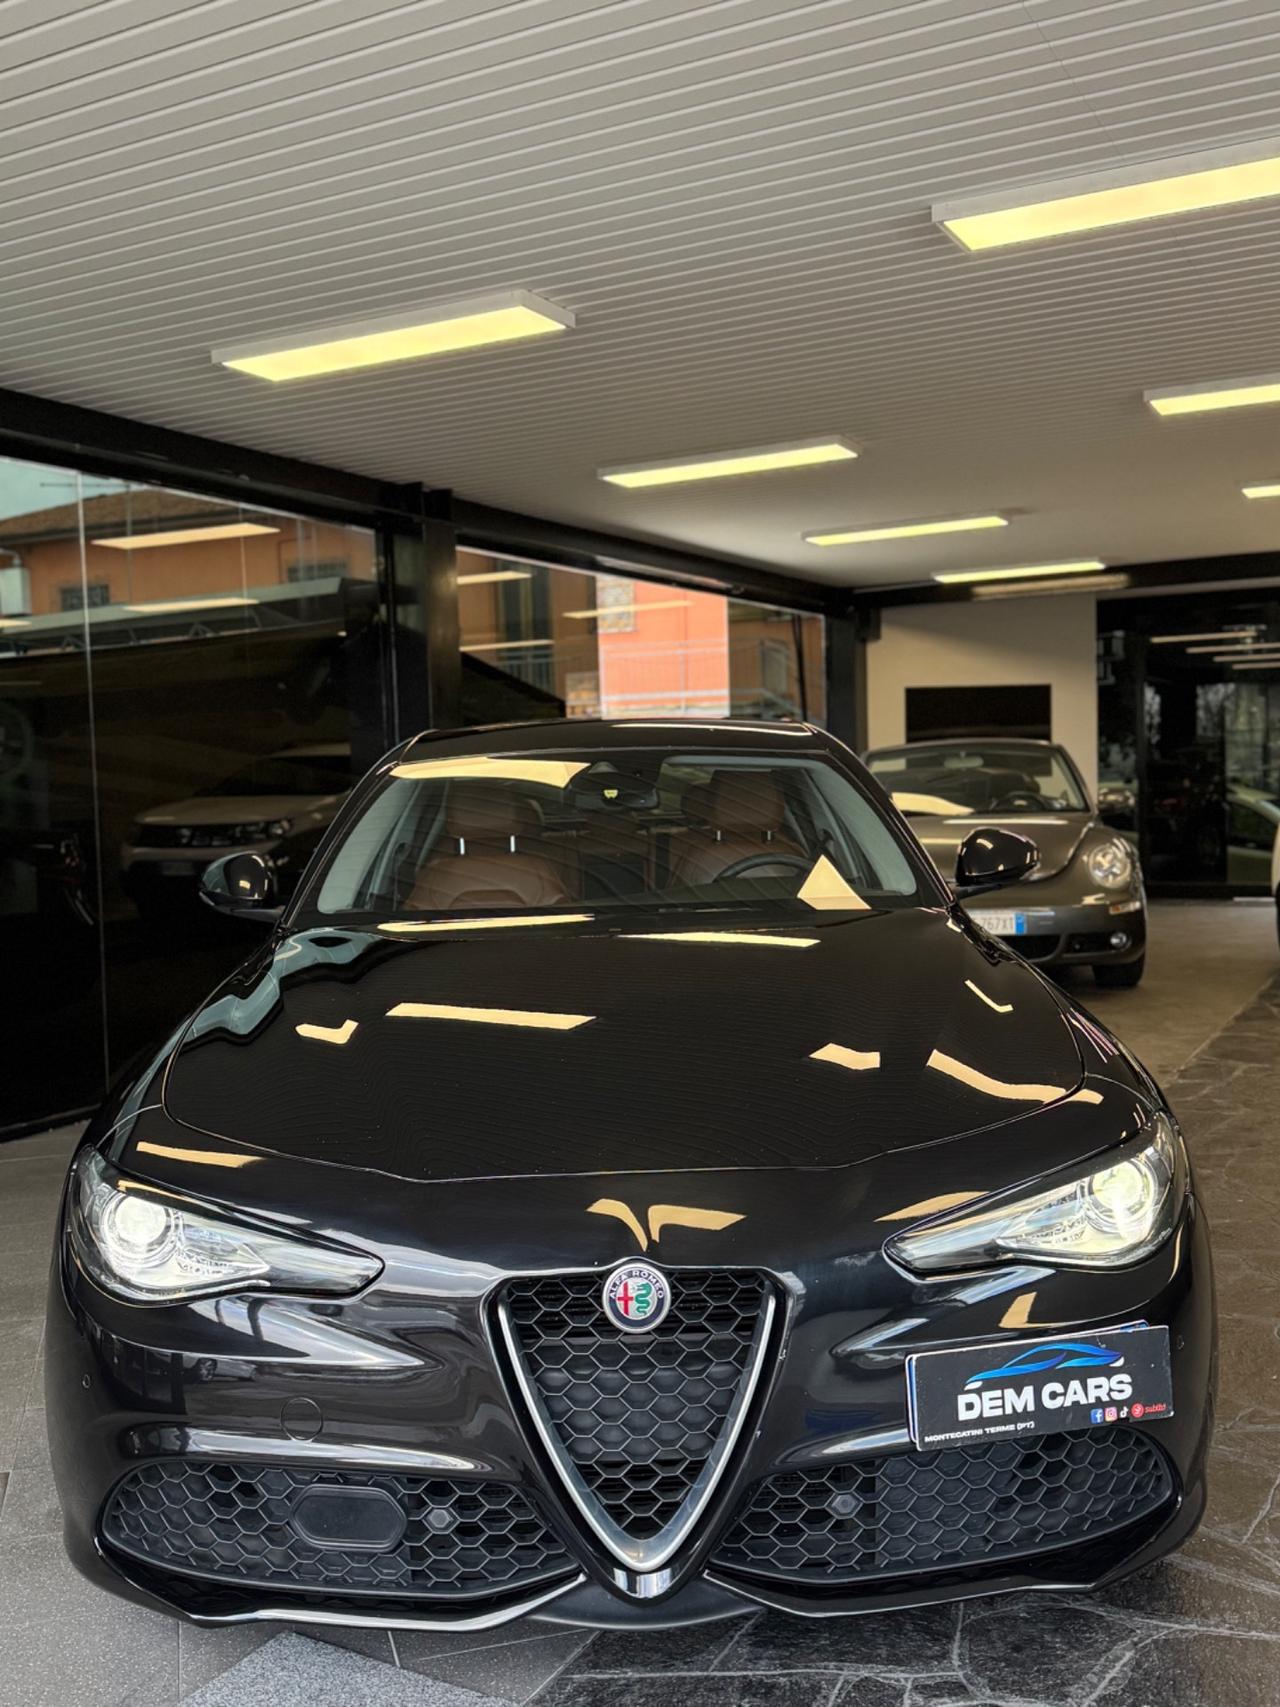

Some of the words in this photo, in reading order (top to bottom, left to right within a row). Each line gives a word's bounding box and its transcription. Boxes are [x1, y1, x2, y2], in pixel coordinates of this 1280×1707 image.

[609, 1273, 629, 1300] ALFA
[631, 1270, 664, 1299] ROMEO
[956, 1385, 1035, 1421] DEM
[1041, 1373, 1132, 1409] CARS
[924, 1428, 983, 1443] MONTECATINI
[984, 1423, 1016, 1435] TERME
